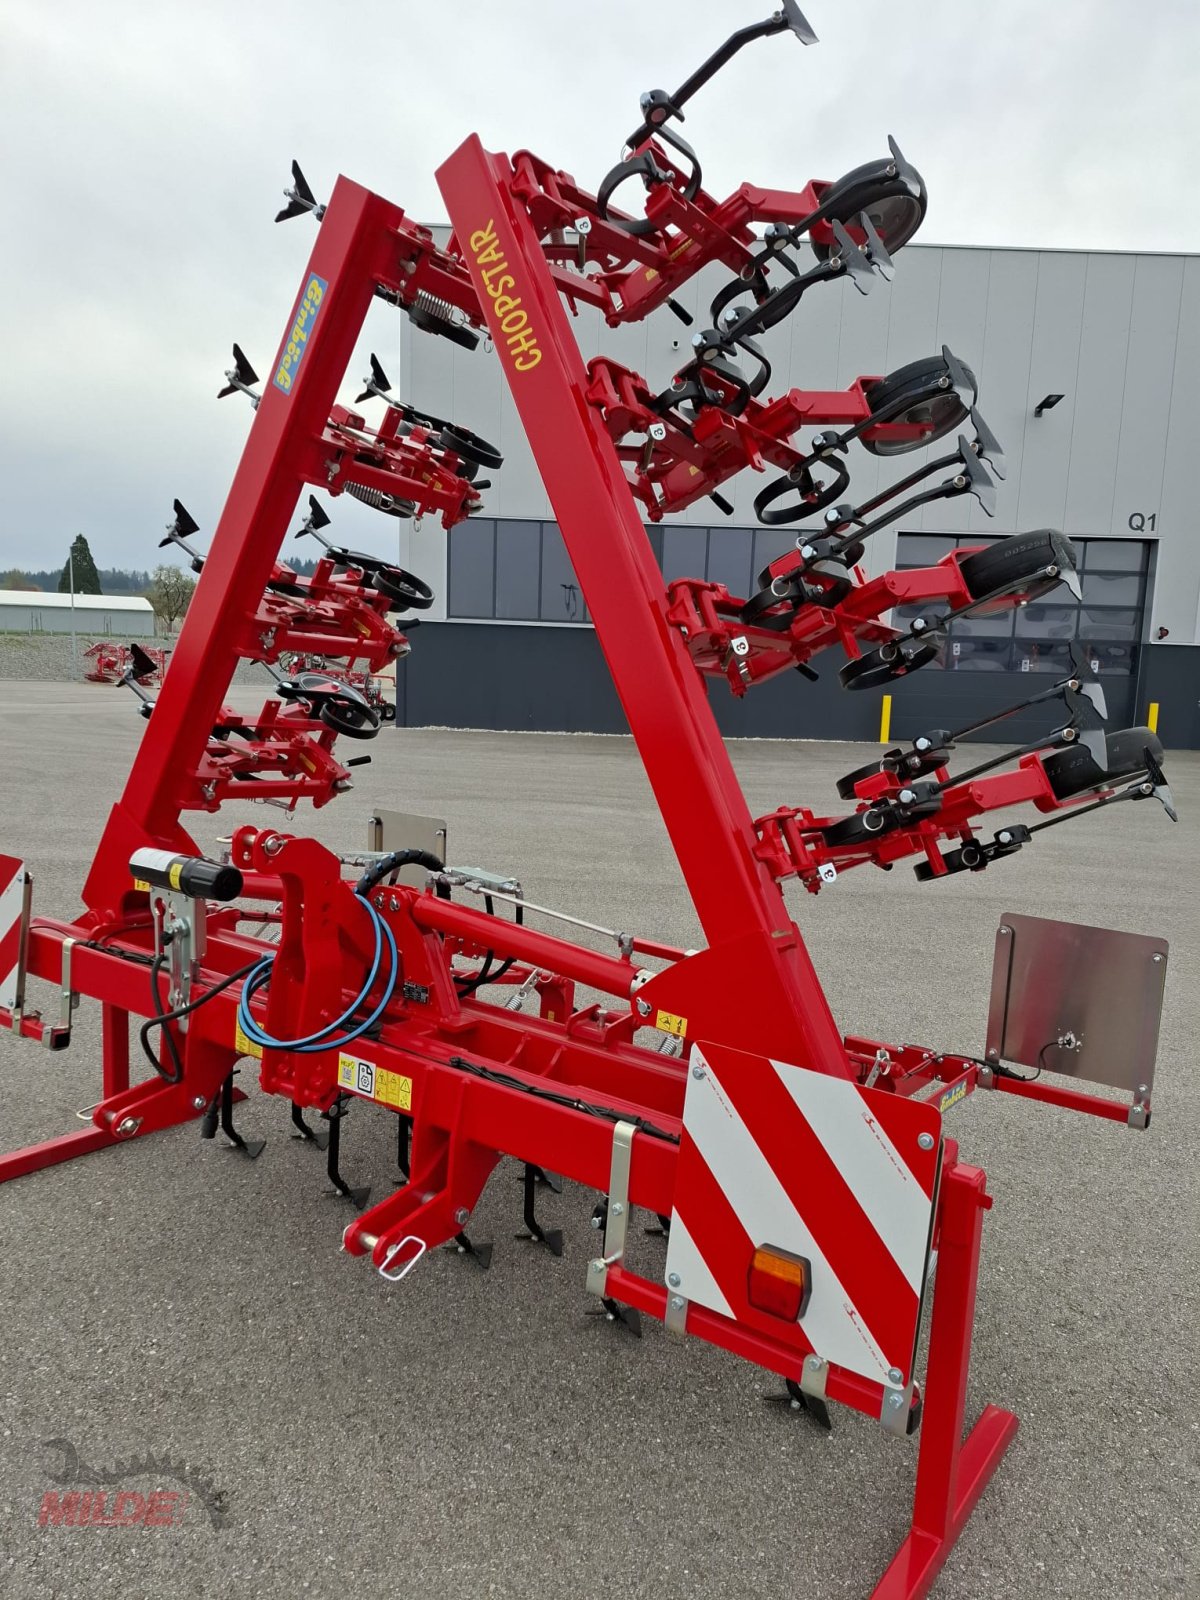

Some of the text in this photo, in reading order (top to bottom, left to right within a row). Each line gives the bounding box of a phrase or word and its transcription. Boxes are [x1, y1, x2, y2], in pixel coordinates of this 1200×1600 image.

[579, 221, 589, 230] 3
[469, 219, 542, 371] CHOPSTAR
[277, 279, 323, 391] Einböck
[653, 427, 664, 437] 3
[1128, 512, 1157, 532] Q1
[736, 642, 746, 651] 3
[824, 869, 834, 879] 3
